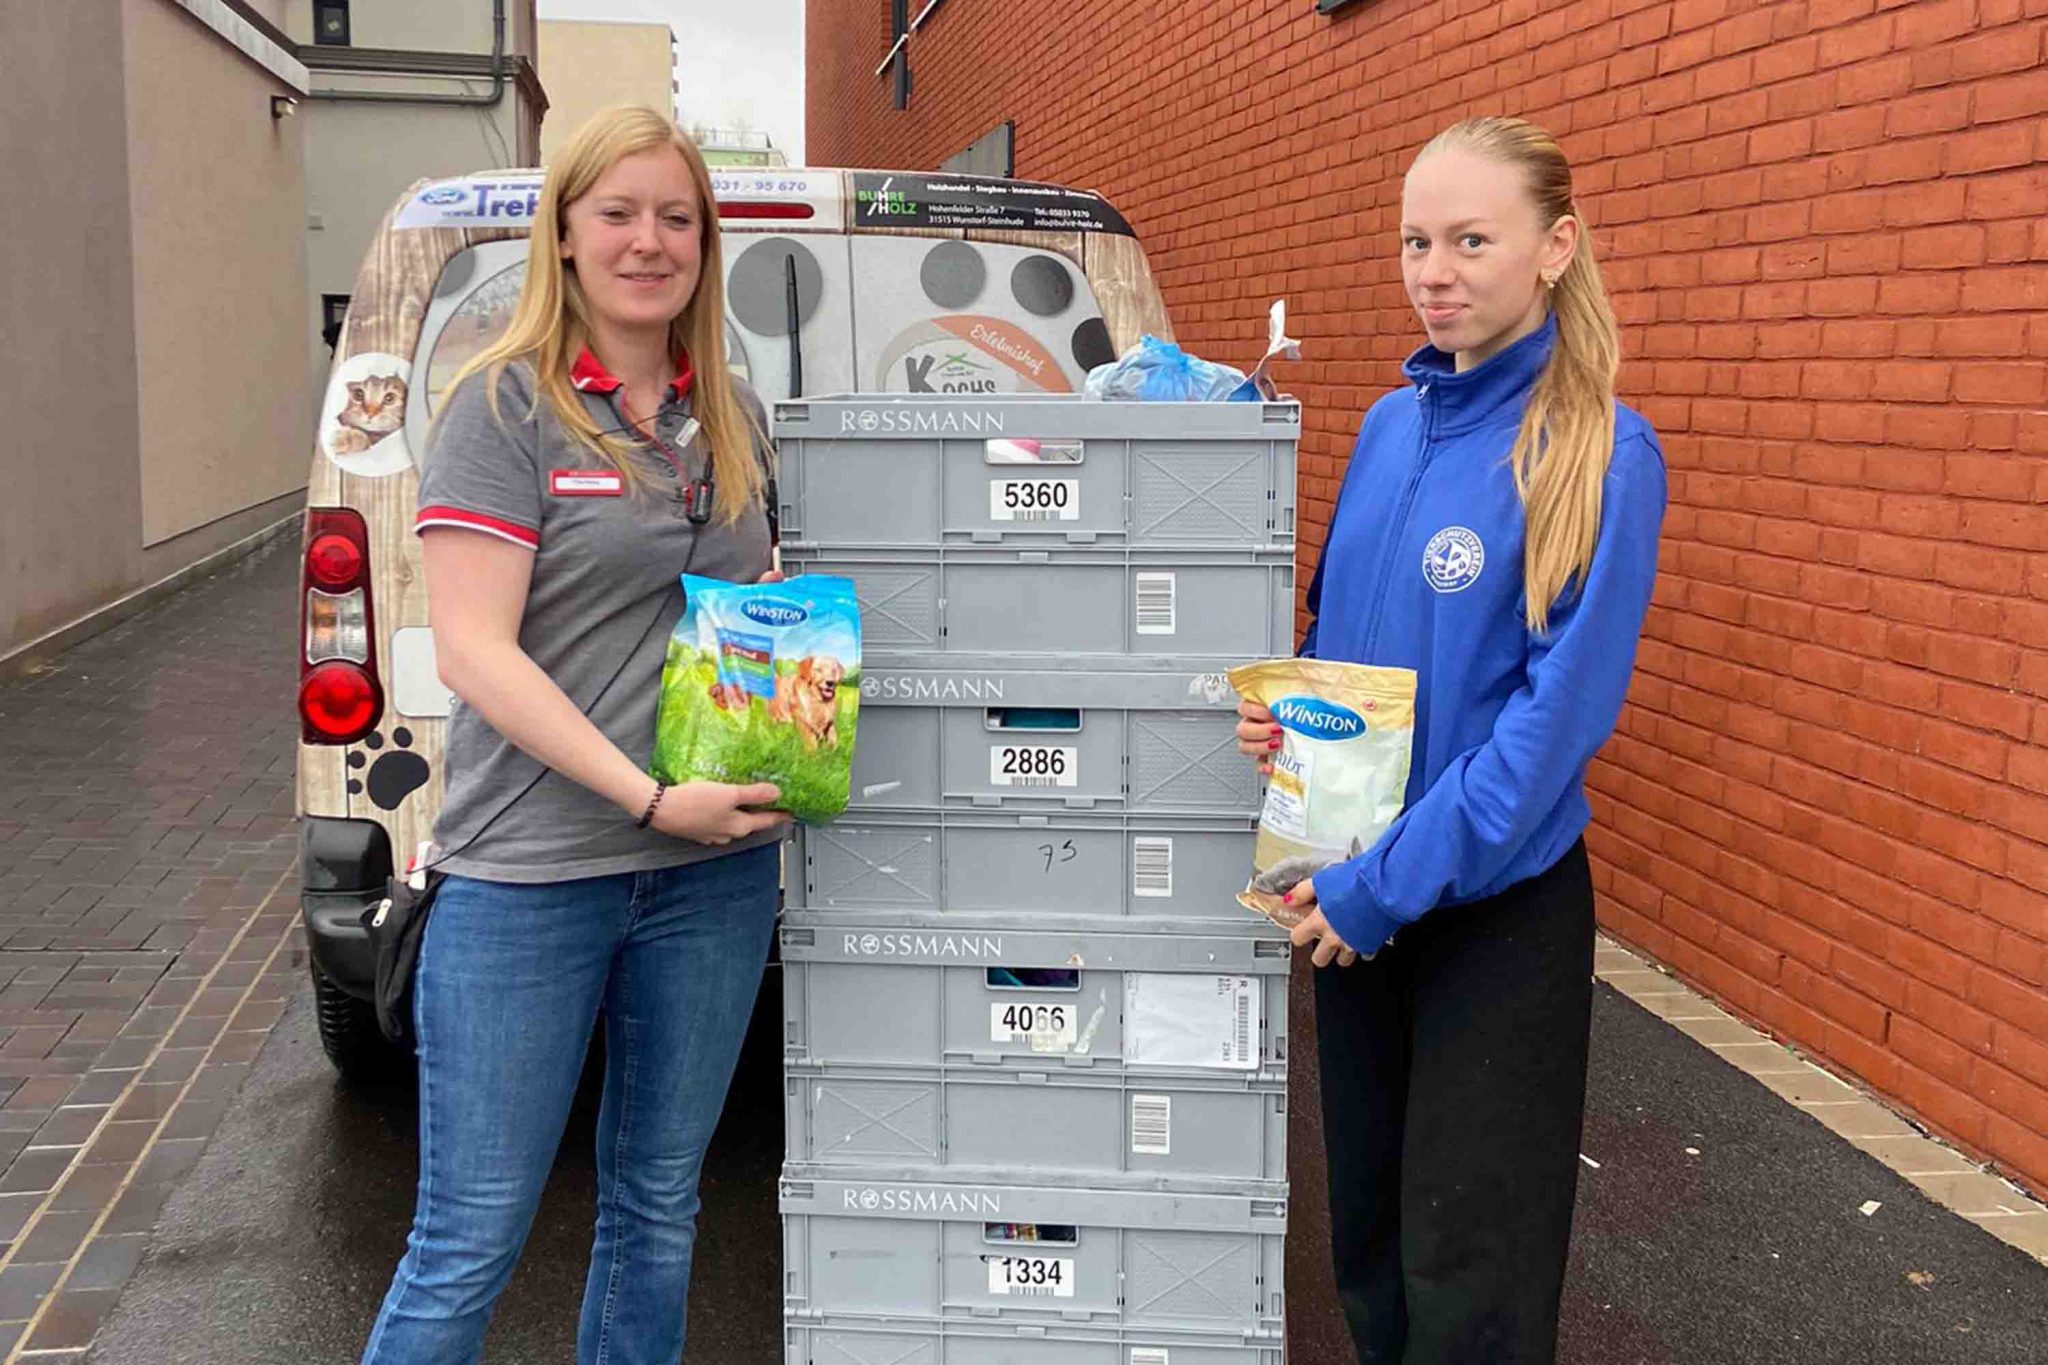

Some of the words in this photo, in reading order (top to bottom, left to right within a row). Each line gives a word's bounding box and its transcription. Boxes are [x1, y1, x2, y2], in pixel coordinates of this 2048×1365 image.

[754, 180, 774, 191] 95
[778, 181, 808, 192] 670
[877, 202, 917, 215] HOLZ
[999, 206, 1006, 214] 7
[970, 323, 1045, 376] Erlebnishof
[841, 409, 1004, 432] ROSSMANN
[1004, 482, 1068, 508] 5360
[859, 676, 1003, 699] OSSMANN
[1002, 748, 1065, 774] 2886
[843, 934, 1002, 958] ROSSMANN
[1002, 1005, 1065, 1032] 4066
[843, 1188, 1001, 1213] ROSSMANN
[1002, 1257, 1063, 1285] 1334
